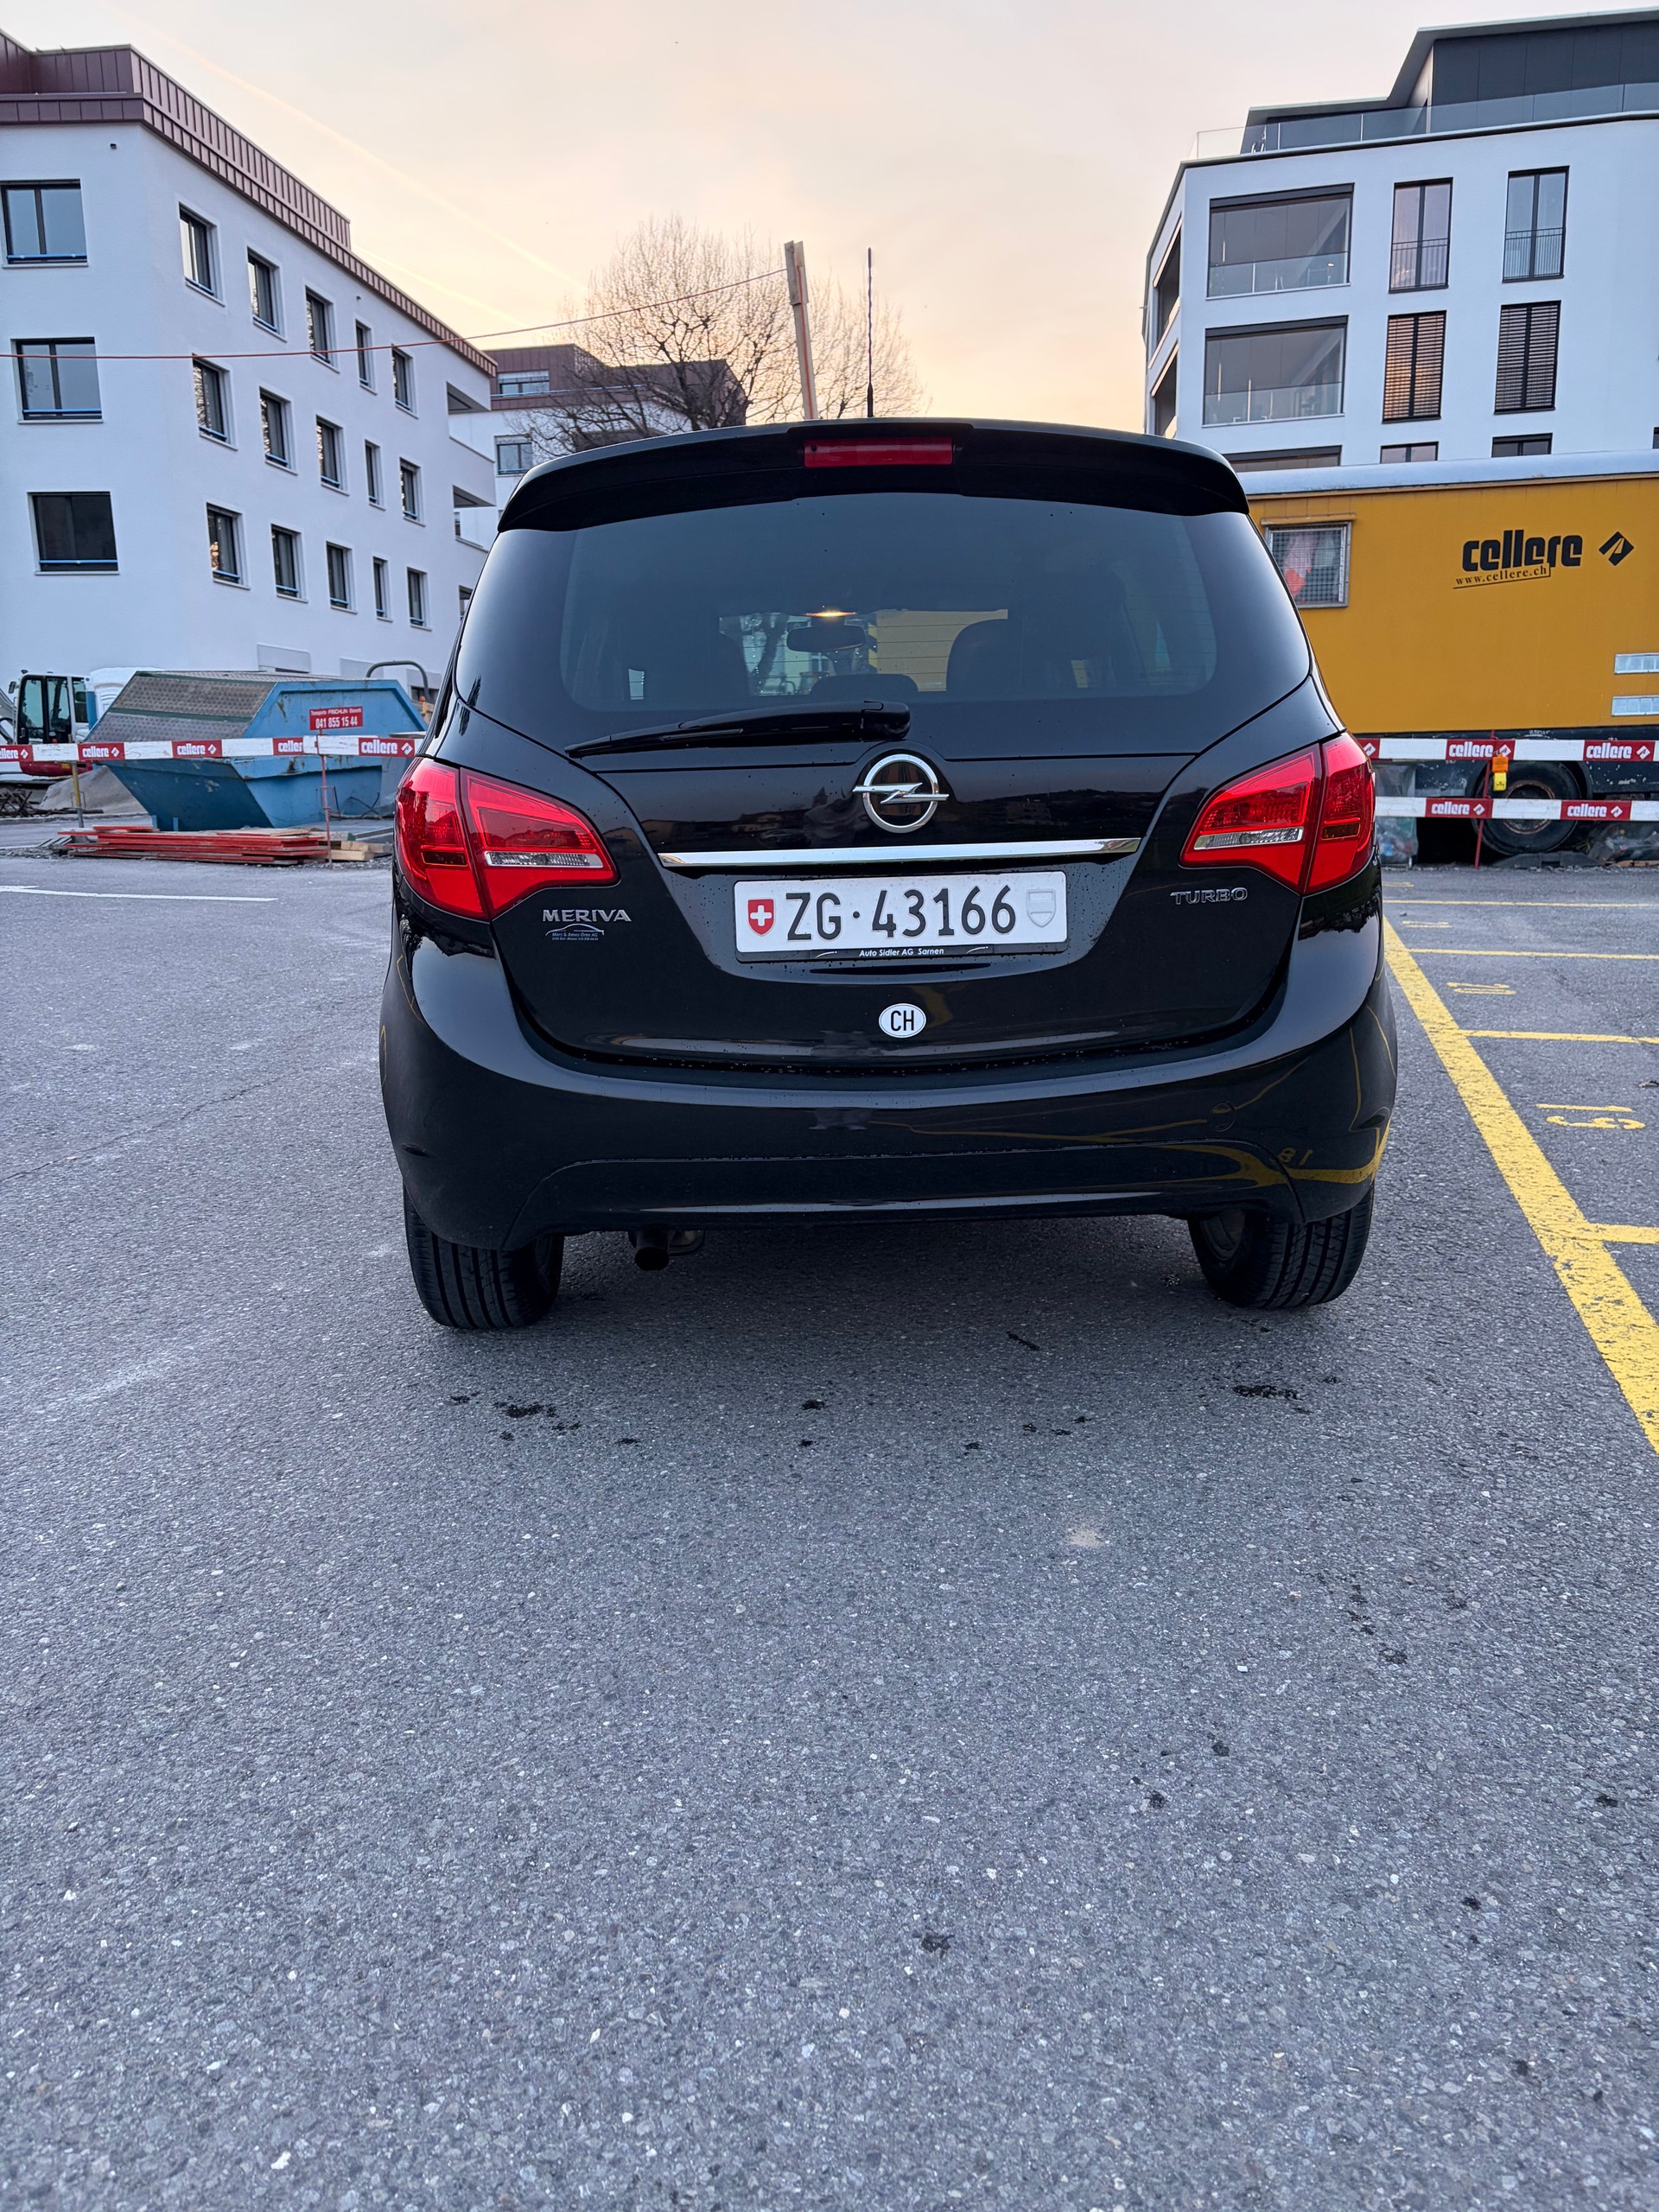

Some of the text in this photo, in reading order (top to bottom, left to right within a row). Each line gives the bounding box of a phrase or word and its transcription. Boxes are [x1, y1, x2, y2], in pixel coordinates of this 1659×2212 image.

[1462, 529, 1583, 572] cellere
[1455, 565, 1547, 586] www.cellere.ch
[315, 715, 358, 729] 041 855 15 44
[0, 747, 18, 760] llere
[81, 746, 109, 758] cellere
[176, 742, 206, 755] cellere
[277, 740, 302, 753] celler
[360, 739, 397, 754] cellere
[1448, 741, 1493, 758] cellere
[1586, 744, 1632, 760] cellere
[1431, 801, 1471, 816] cellere
[1567, 804, 1608, 819] cellere
[1170, 887, 1249, 906] TURBO
[543, 909, 632, 922] MERIVA
[890, 1009, 915, 1032] CH
